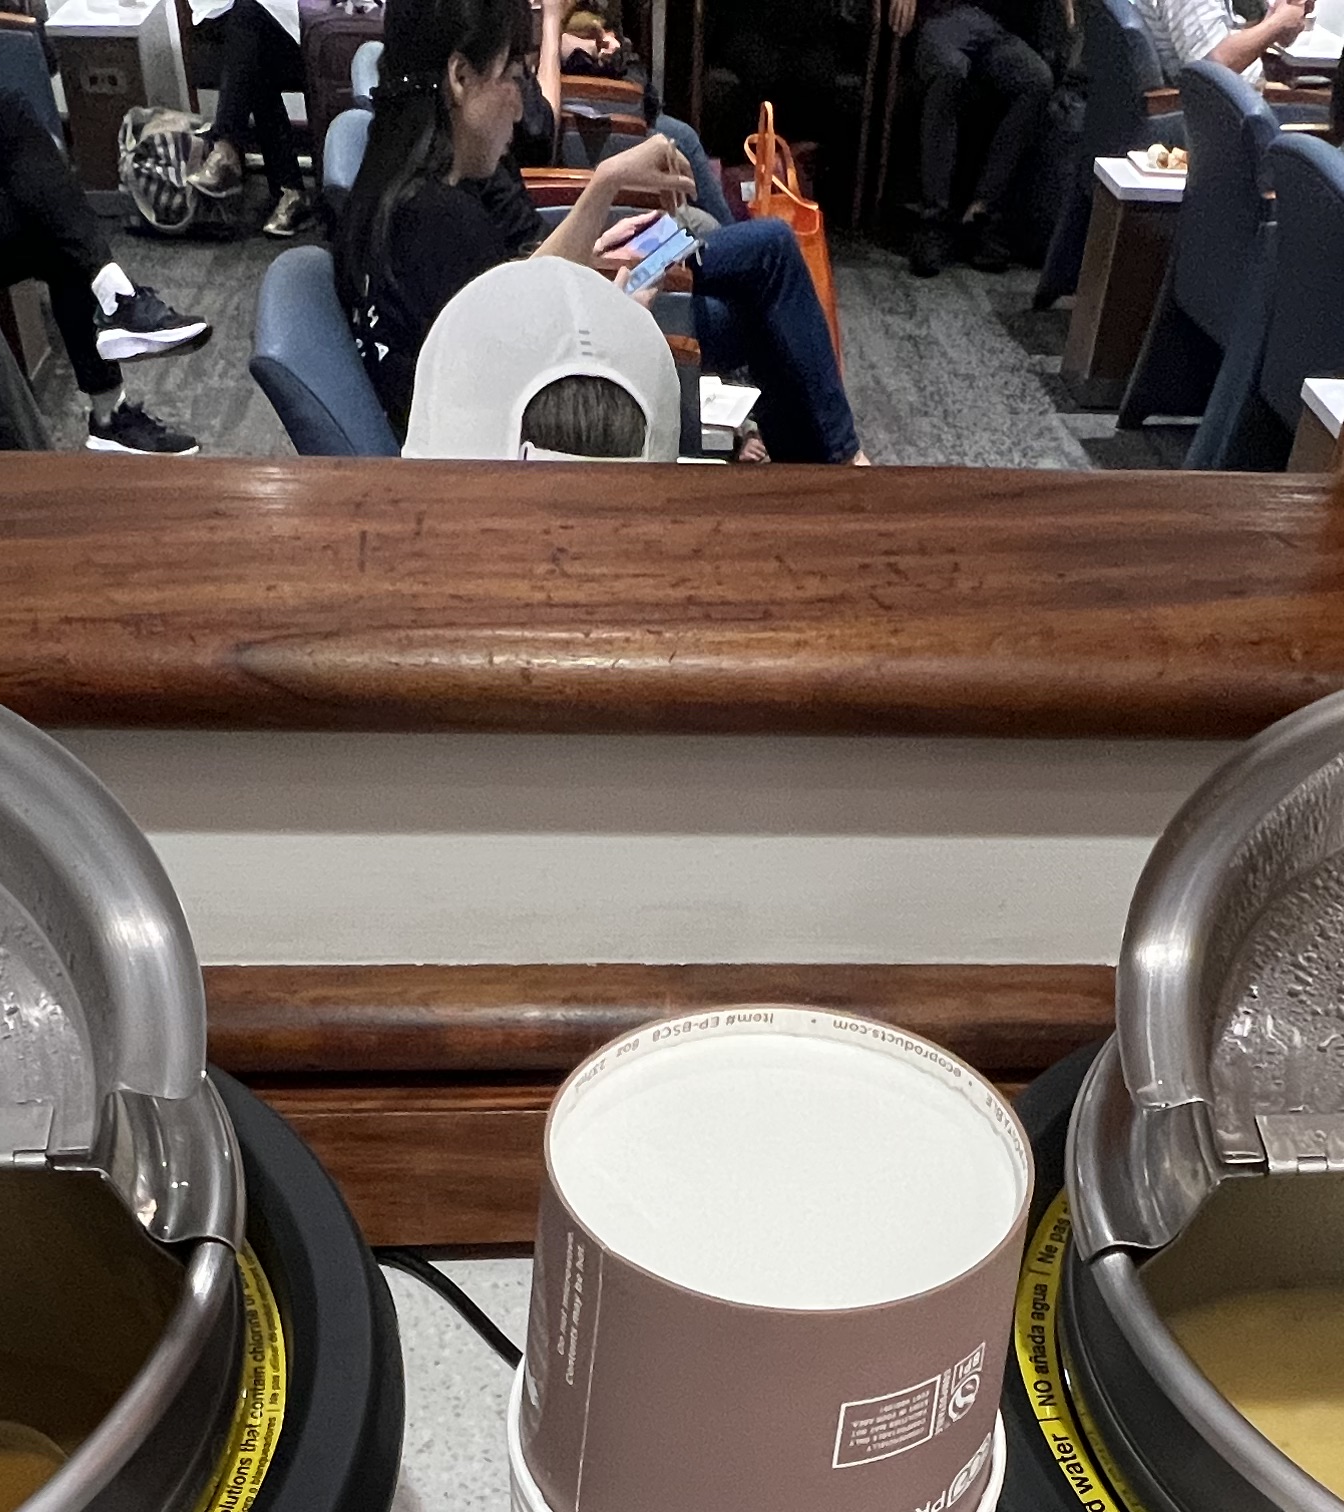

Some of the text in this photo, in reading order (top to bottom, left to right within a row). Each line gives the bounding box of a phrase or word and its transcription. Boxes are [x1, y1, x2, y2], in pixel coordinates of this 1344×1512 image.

[832, 1018, 963, 1078] ecoproducts.com
[1037, 1241, 1059, 1264] Ne
[958, 1351, 981, 1379] BPI
[1027, 1283, 1058, 1407] NO añada agua
[240, 1424, 262, 1452] that
[251, 1365, 266, 1420] contain
[1052, 1433, 1094, 1495] water
